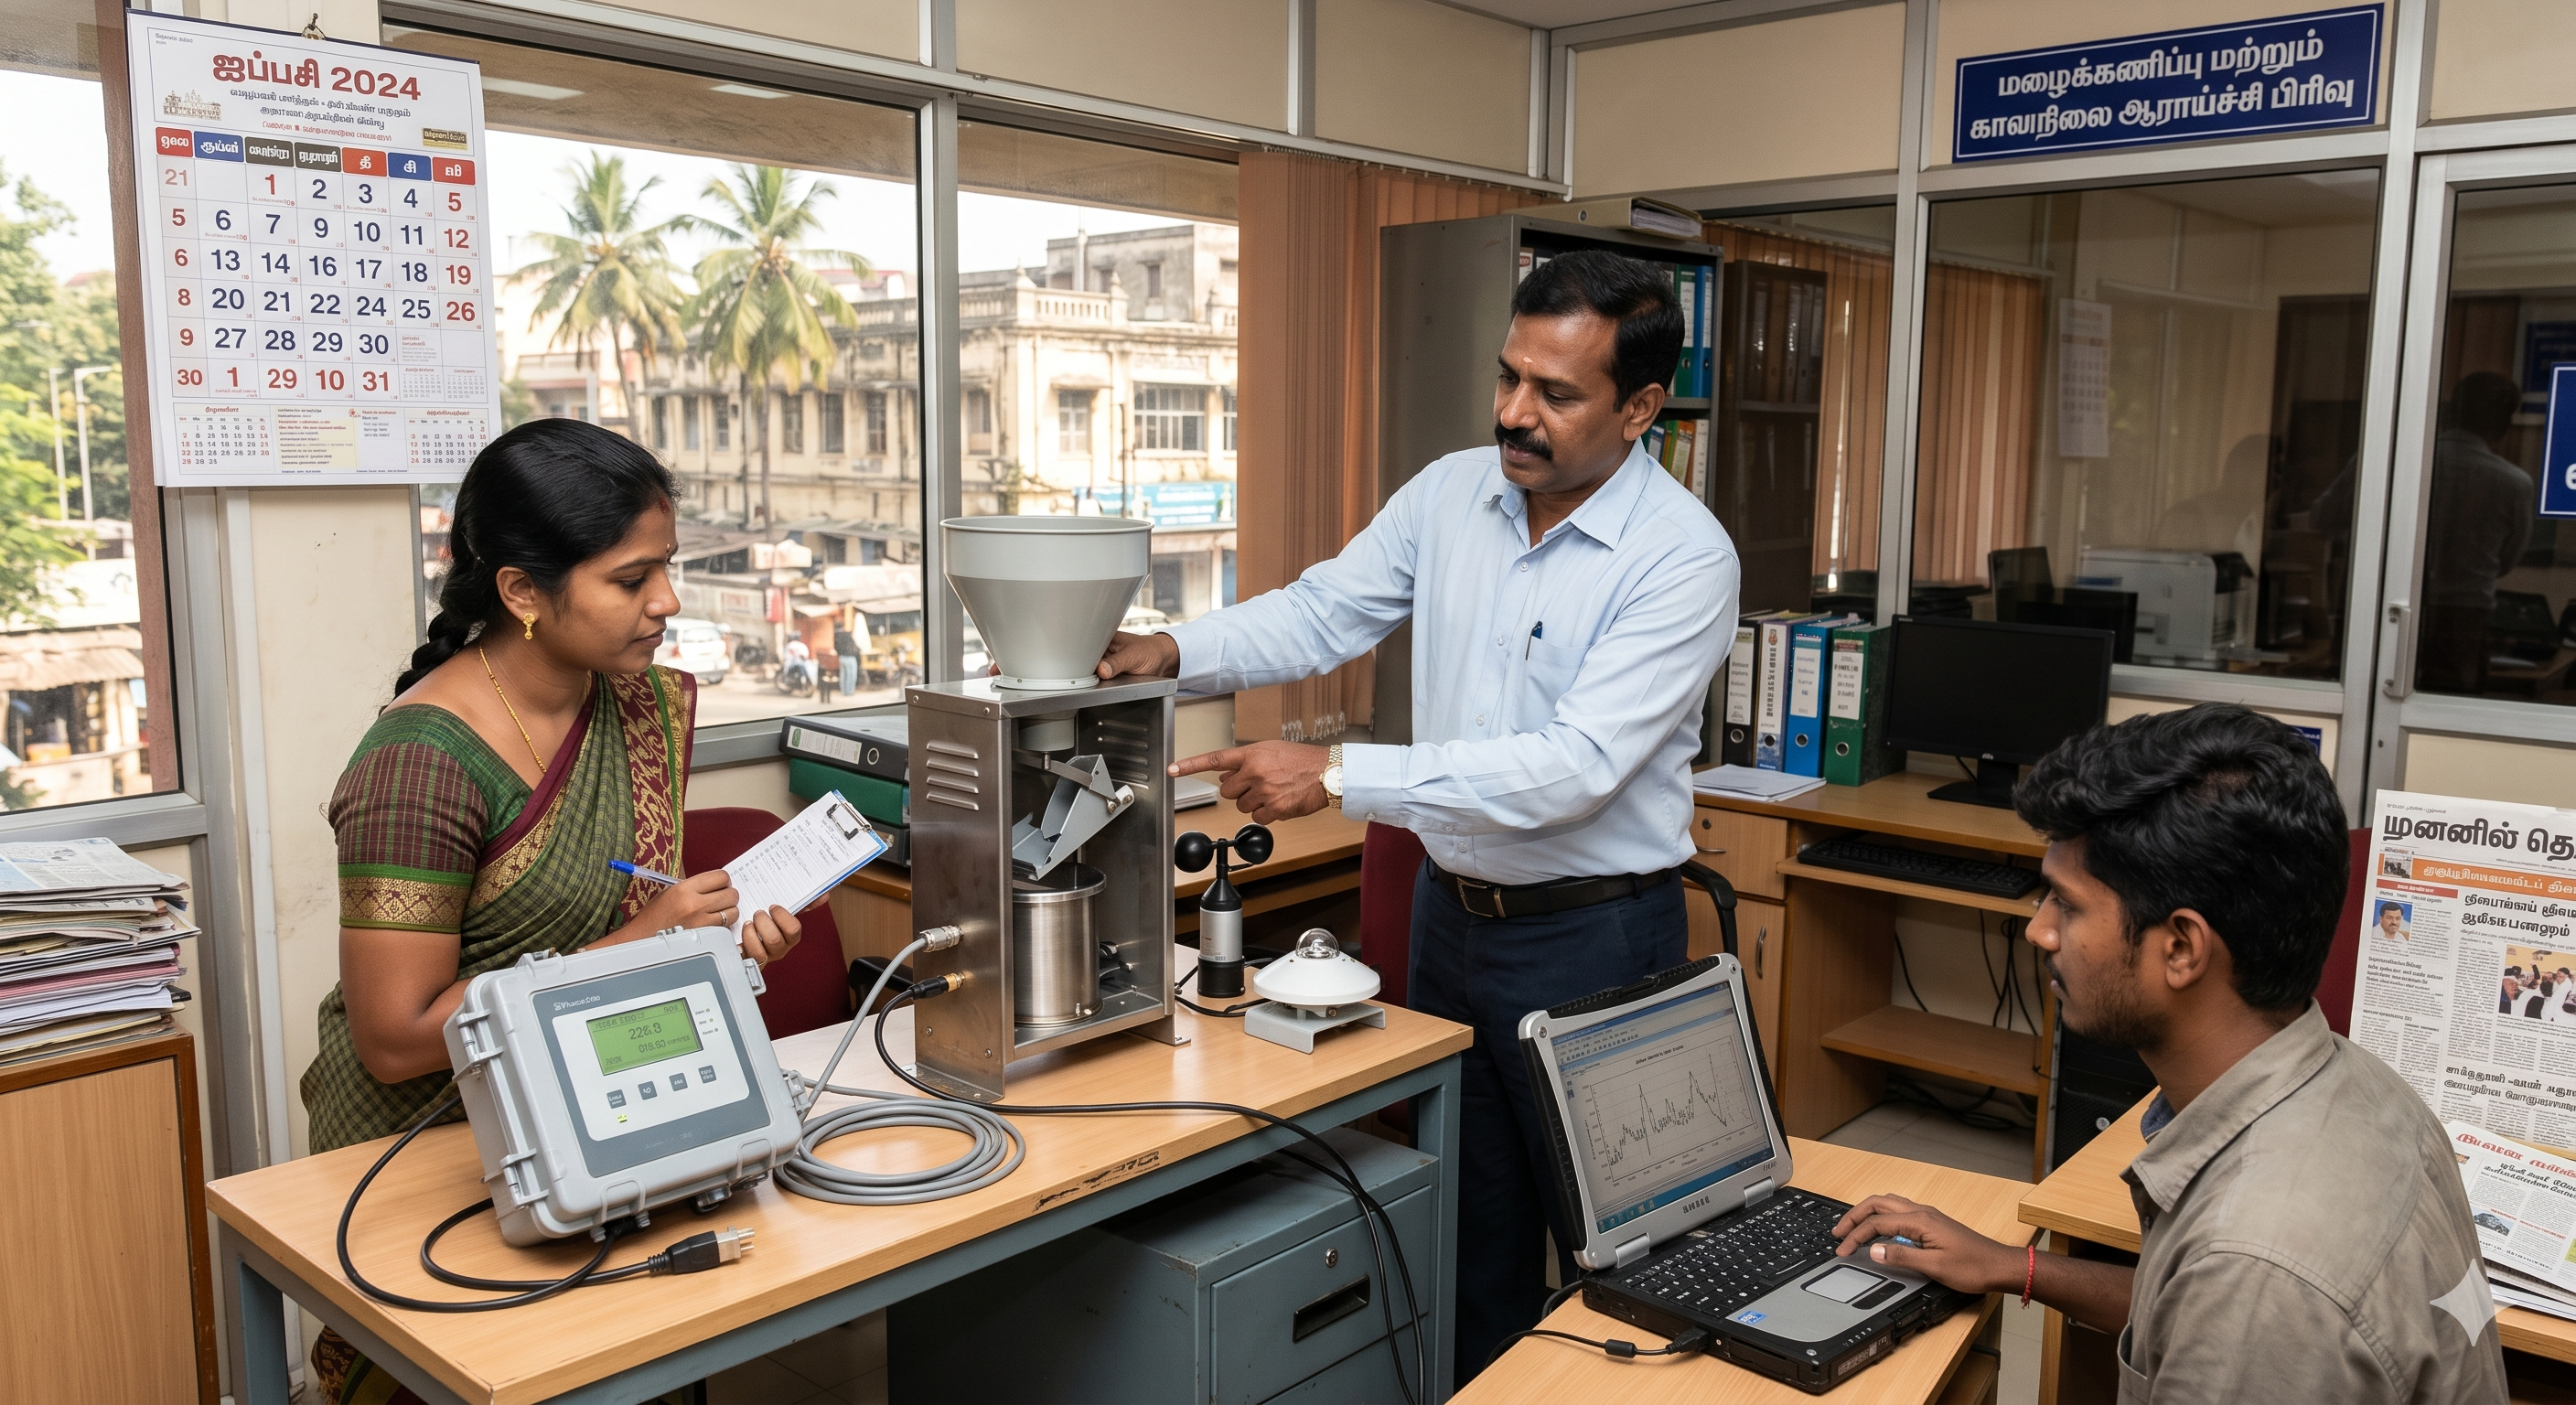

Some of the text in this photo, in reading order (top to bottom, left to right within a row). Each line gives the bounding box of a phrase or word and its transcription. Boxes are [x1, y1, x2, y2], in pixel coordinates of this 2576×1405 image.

[212, 50, 422, 101] ஐப்பசி 2024
[1998, 28, 2324, 99] மழைக்கணிப்பு மற்றும்
[2118, 81, 2263, 127] ஆராய்ச்சி
[2270, 73, 2355, 110] பிரிவு
[166, 169, 461, 211] 21 1 2 3 4 5
[172, 209, 468, 249] 5 6 7 9 10 11 12
[175, 249, 471, 284] 6 13 14 16 17 18 19
[178, 288, 475, 321] 8 20 21 22 24 25 26
[180, 328, 193, 346] 9
[215, 327, 246, 349] 27
[265, 330, 295, 350] 28
[313, 332, 342, 352] 29
[360, 334, 388, 354] 30
[177, 370, 202, 385] 30
[227, 367, 238, 387] 1
[268, 369, 296, 389] 29
[316, 370, 344, 390] 10
[363, 371, 388, 391] 31
[2527, 827, 2576, 862] தெ
